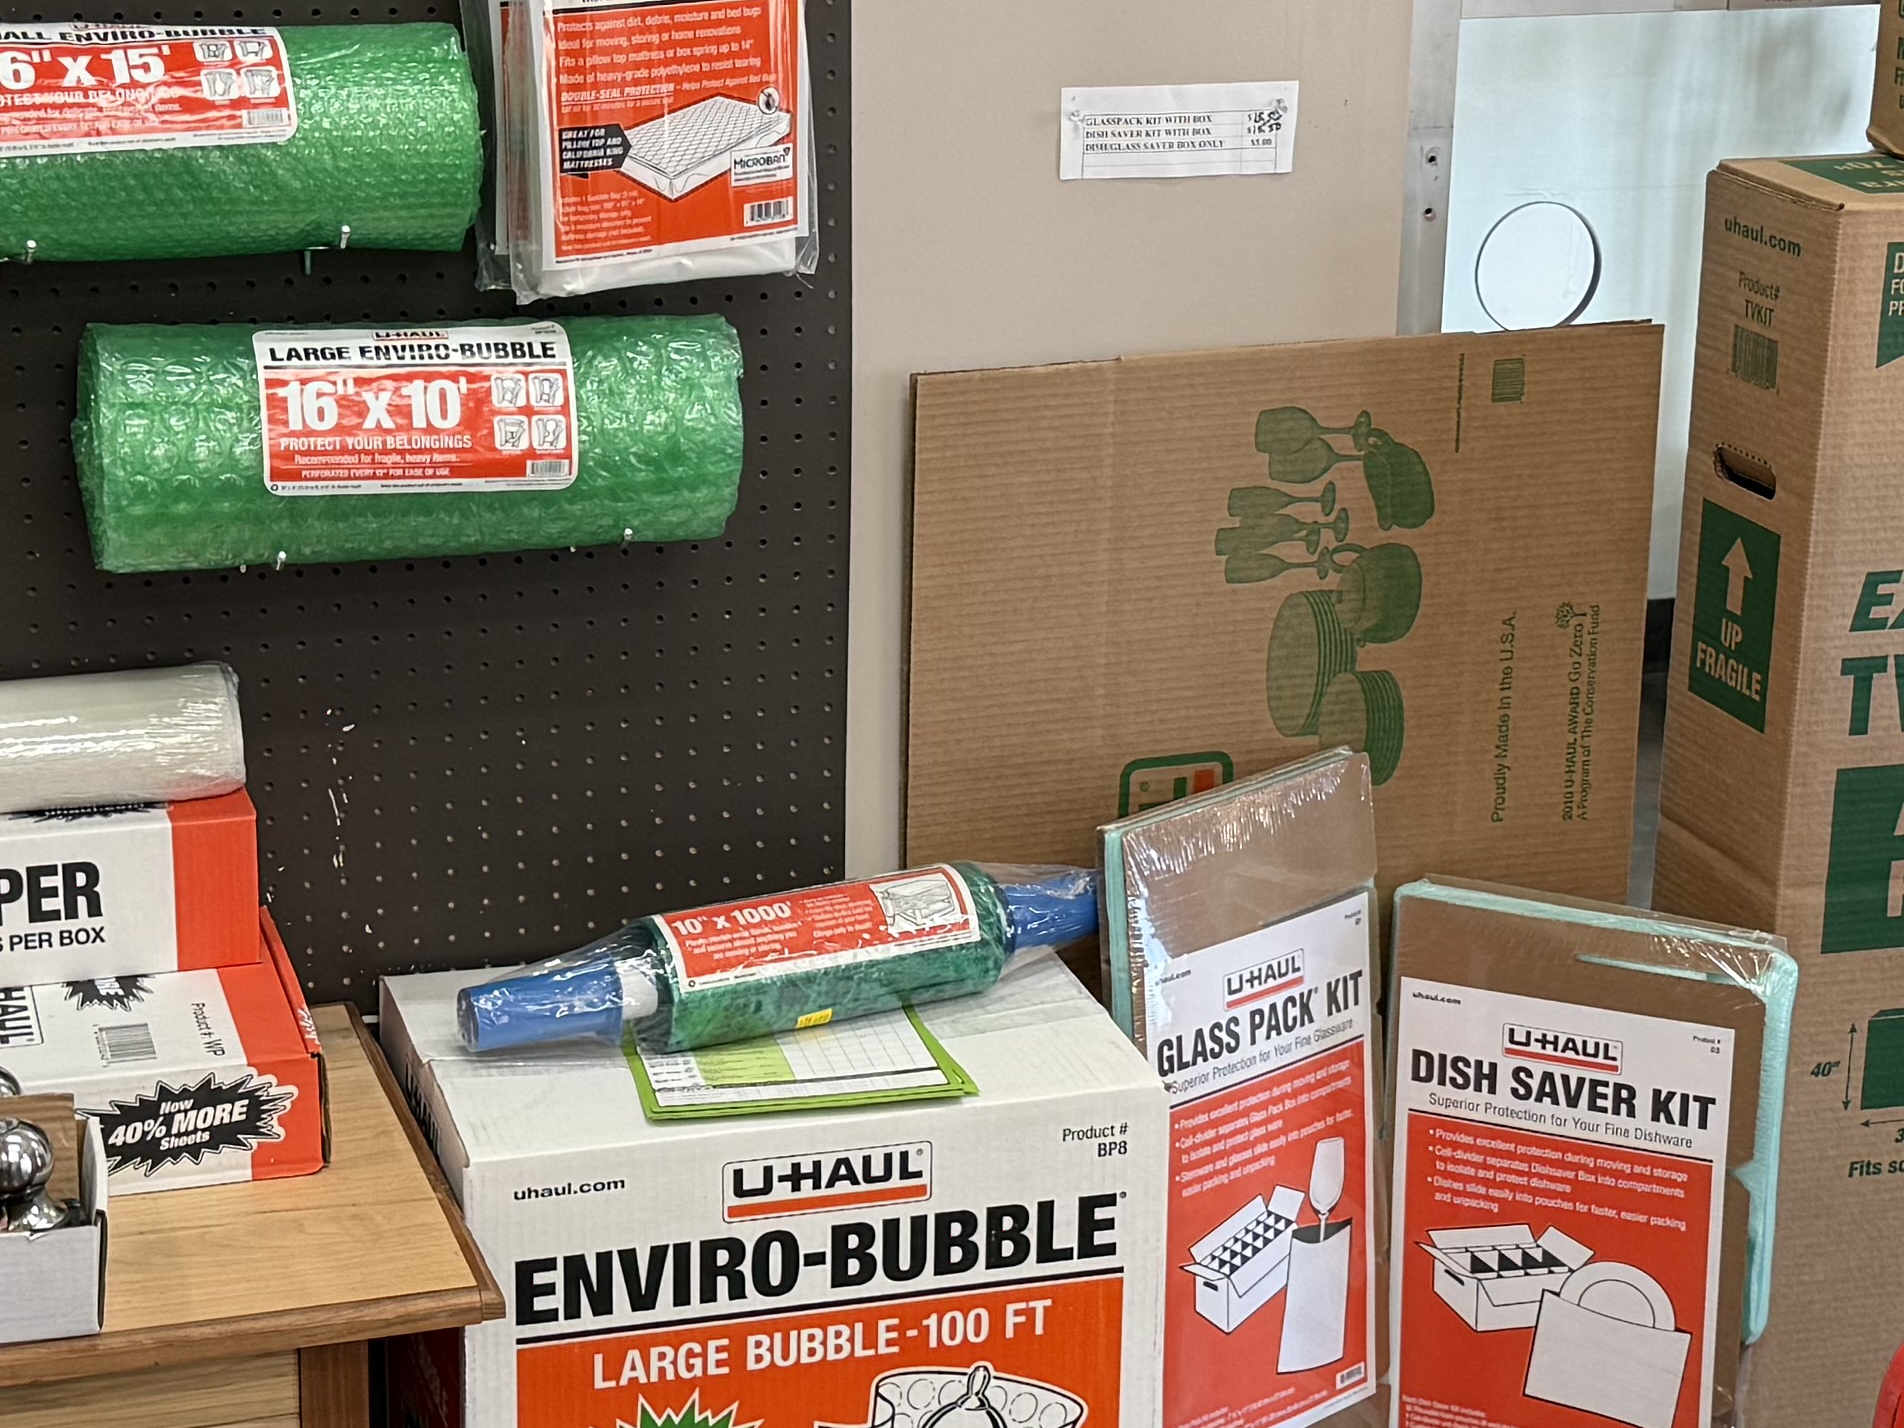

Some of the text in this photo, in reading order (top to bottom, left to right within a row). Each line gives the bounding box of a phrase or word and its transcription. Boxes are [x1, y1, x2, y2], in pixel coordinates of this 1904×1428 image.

[1146, 116, 1161, 125] KIT
[1165, 115, 1190, 124] WITH
[1193, 115, 1212, 123] BOX
[1744, 299, 1775, 327] TVKIT
[270, 342, 556, 362] LARGE ENVIRO-BUBBLE
[1500, 610, 1517, 660] U.S.A.
[1500, 666, 1513, 691] the
[1494, 714, 1510, 759] Made
[1491, 766, 1511, 823] Proudly
[9, 932, 54, 953] PER
[58, 927, 105, 947] BOX
[1156, 970, 1364, 1078] GLASS PACK KIT
[1411, 1048, 1716, 1130] DISH SAVER KIT
[108, 1099, 249, 1147] 40% MORE
[160, 1131, 210, 1150] Sheets
[1428, 1092, 1692, 1149] Superior Protection for Your Fine Dishware
[1097, 1140, 1128, 1158] BP8
[1848, 1160, 1882, 1178] Fits
[514, 1191, 1119, 1327] ENVIRO-BUBBLE
[593, 1337, 731, 1390] LARGE
